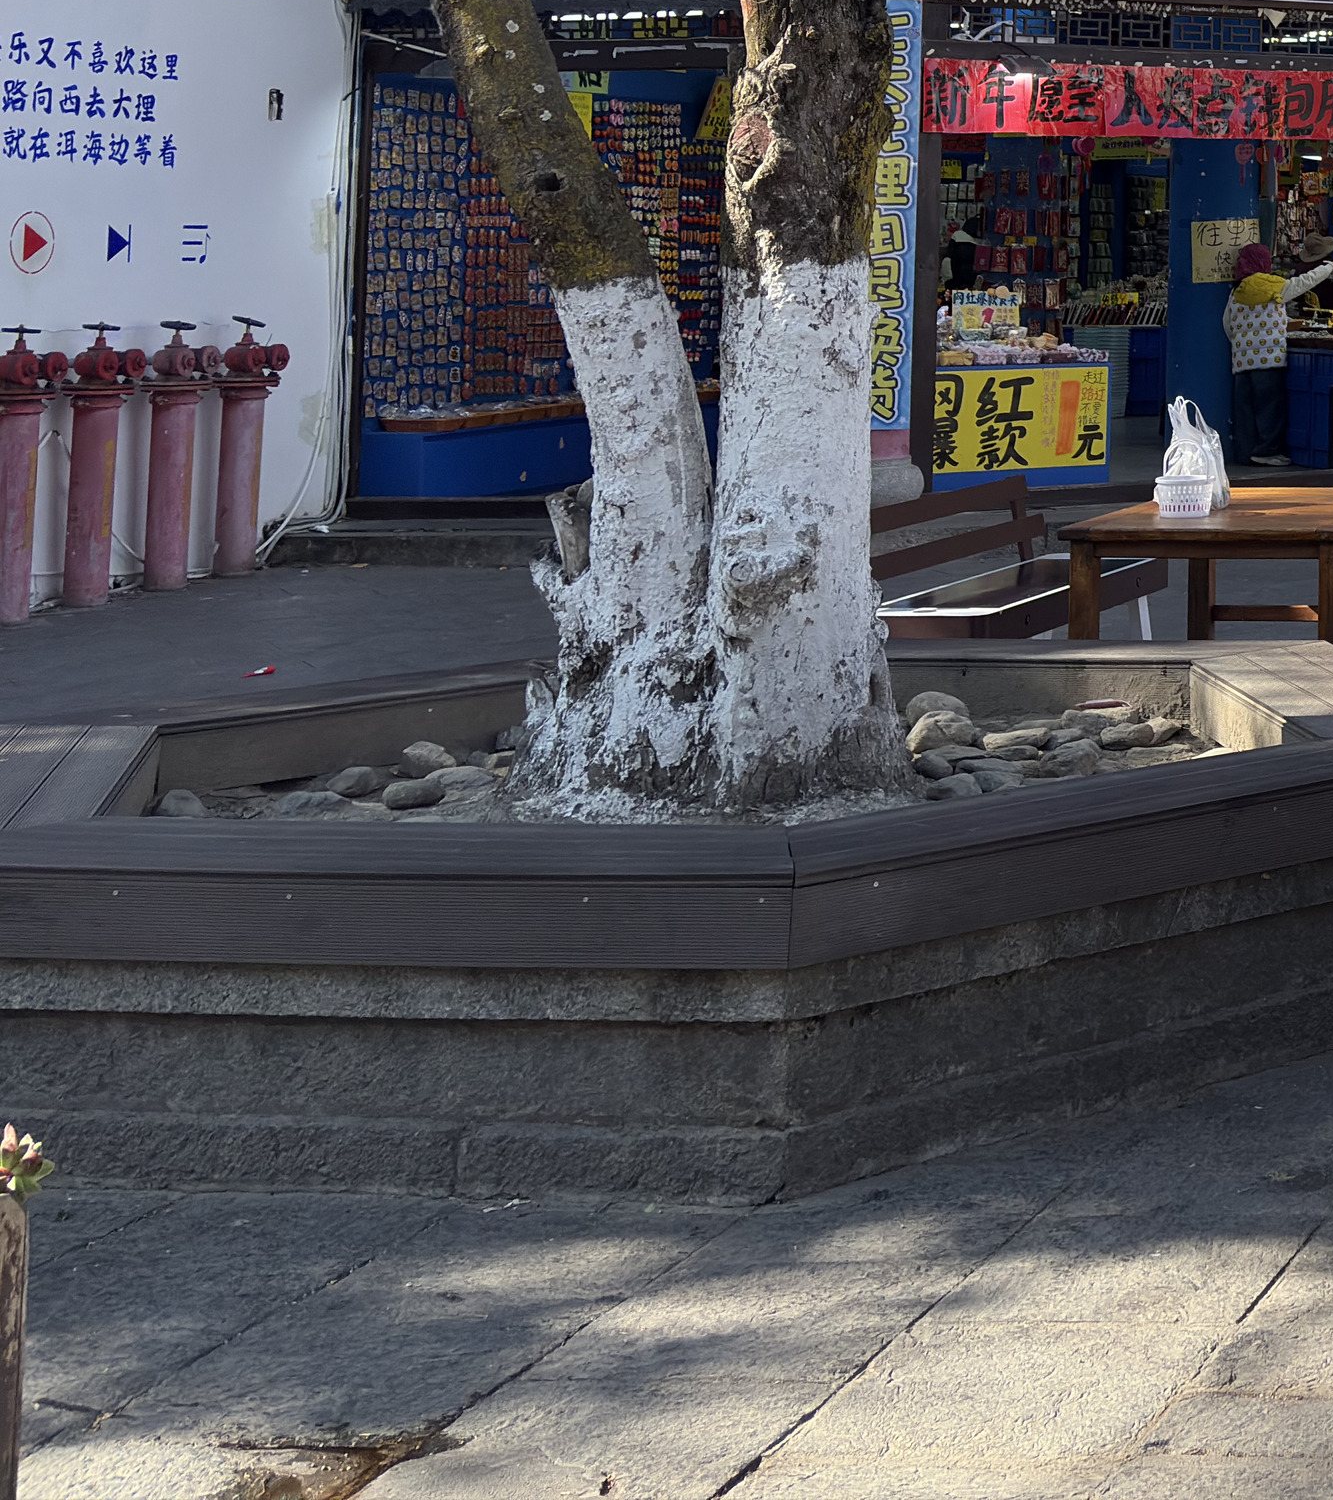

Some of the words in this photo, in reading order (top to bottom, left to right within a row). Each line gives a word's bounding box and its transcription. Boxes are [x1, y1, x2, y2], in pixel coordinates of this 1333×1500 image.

[0, 31, 180, 81] 乐又不喜欢这里
[1, 78, 157, 123] 路向西去大理
[2, 127, 178, 168] 就在洱海边等着
